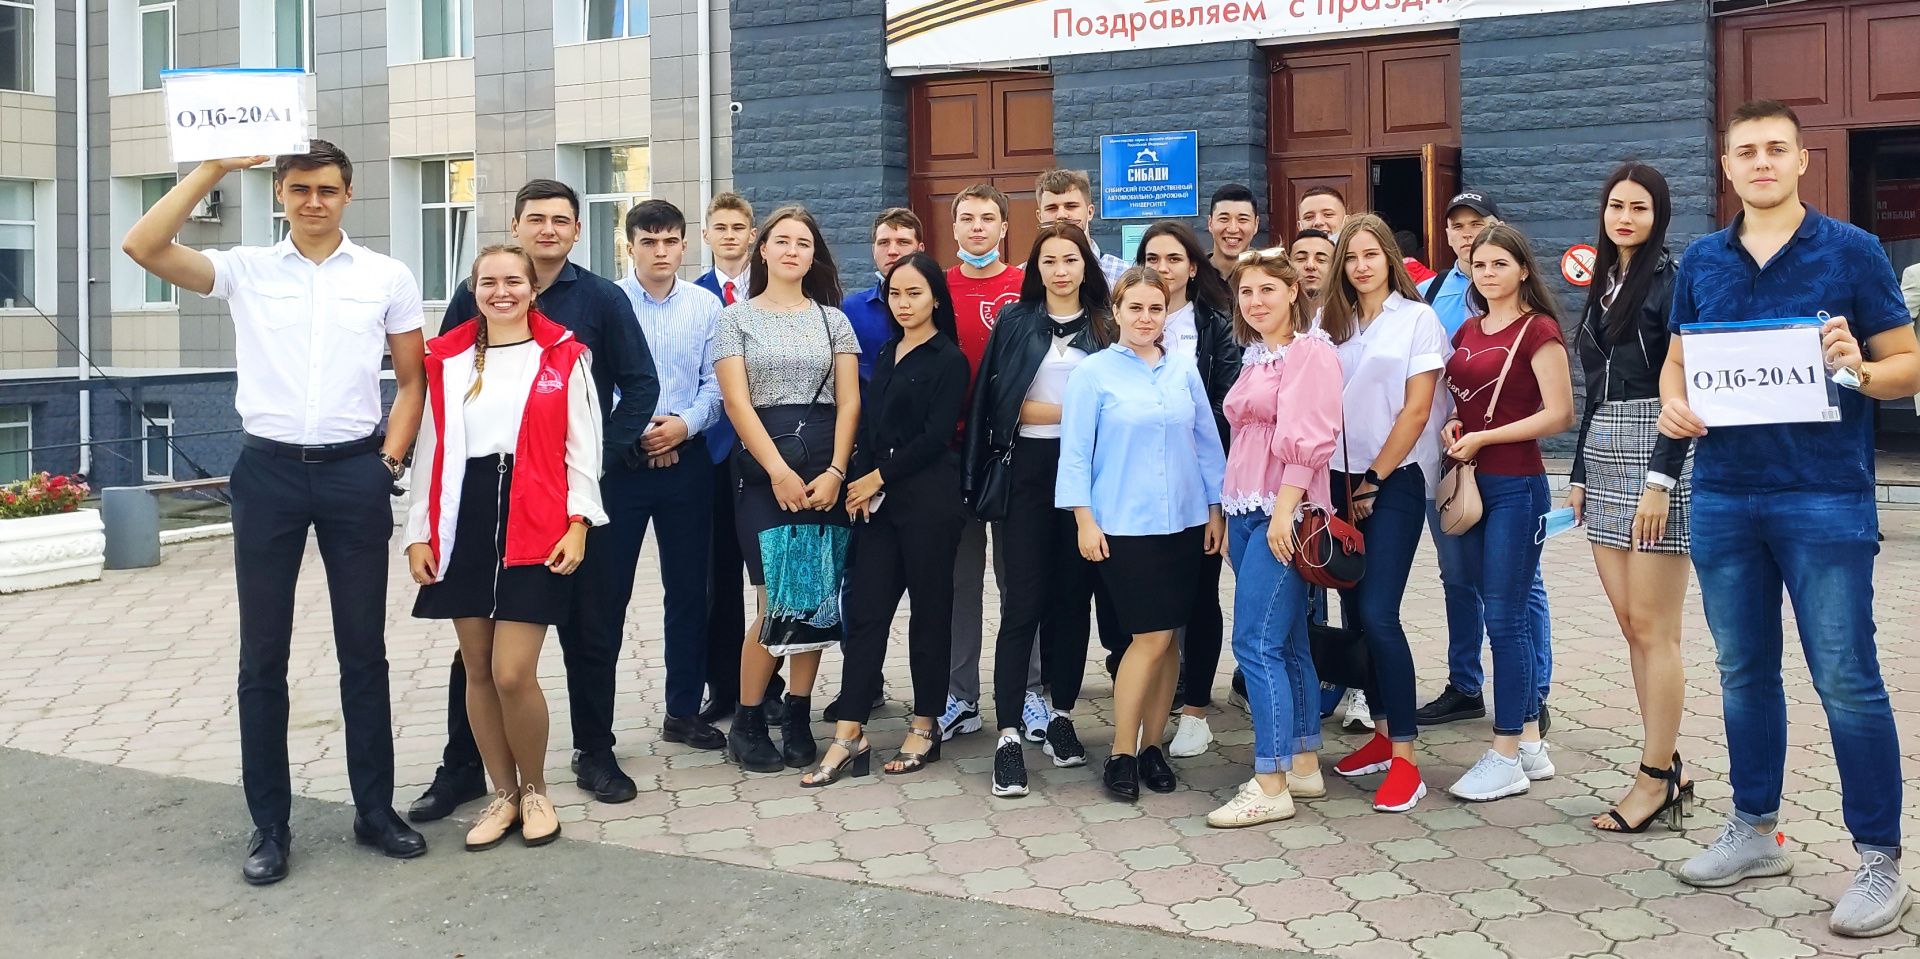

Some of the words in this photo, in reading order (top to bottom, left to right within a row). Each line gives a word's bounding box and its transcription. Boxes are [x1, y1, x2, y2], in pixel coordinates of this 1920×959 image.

[1053, 1, 1267, 42] Поздравляем
[1289, 0, 1305, 17] с
[177, 106, 291, 130] ОДб-20А1
[1128, 167, 1168, 181] СИБАДИ
[1139, 184, 1192, 192] ГОСУДАРСТВЕННЫЙ
[1693, 365, 1816, 394] ОДб-20А1
